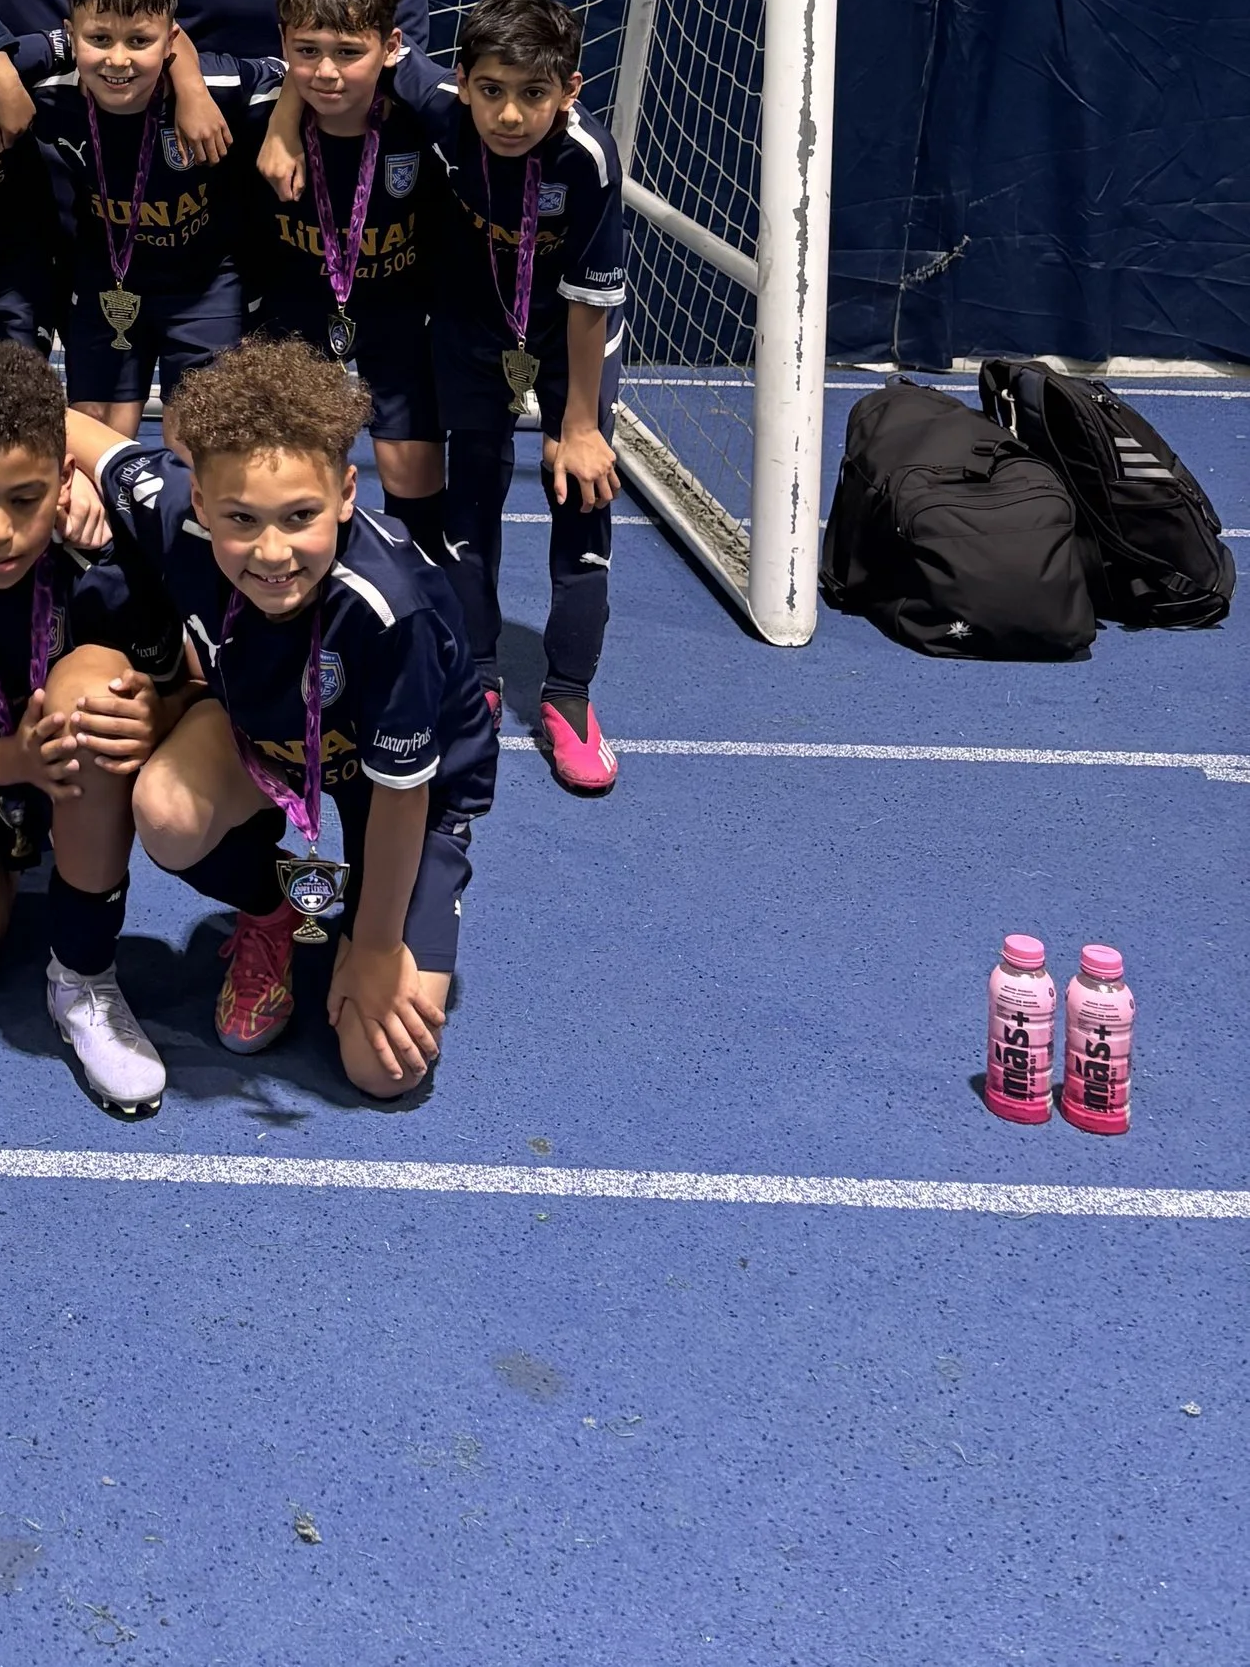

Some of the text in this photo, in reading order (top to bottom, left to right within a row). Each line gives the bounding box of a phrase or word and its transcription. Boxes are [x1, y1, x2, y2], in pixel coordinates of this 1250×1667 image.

[91, 183, 209, 227] iUNA!
[181, 208, 210, 246] 506
[320, 245, 417, 278] Lal 506
[324, 759, 359, 785] 50
